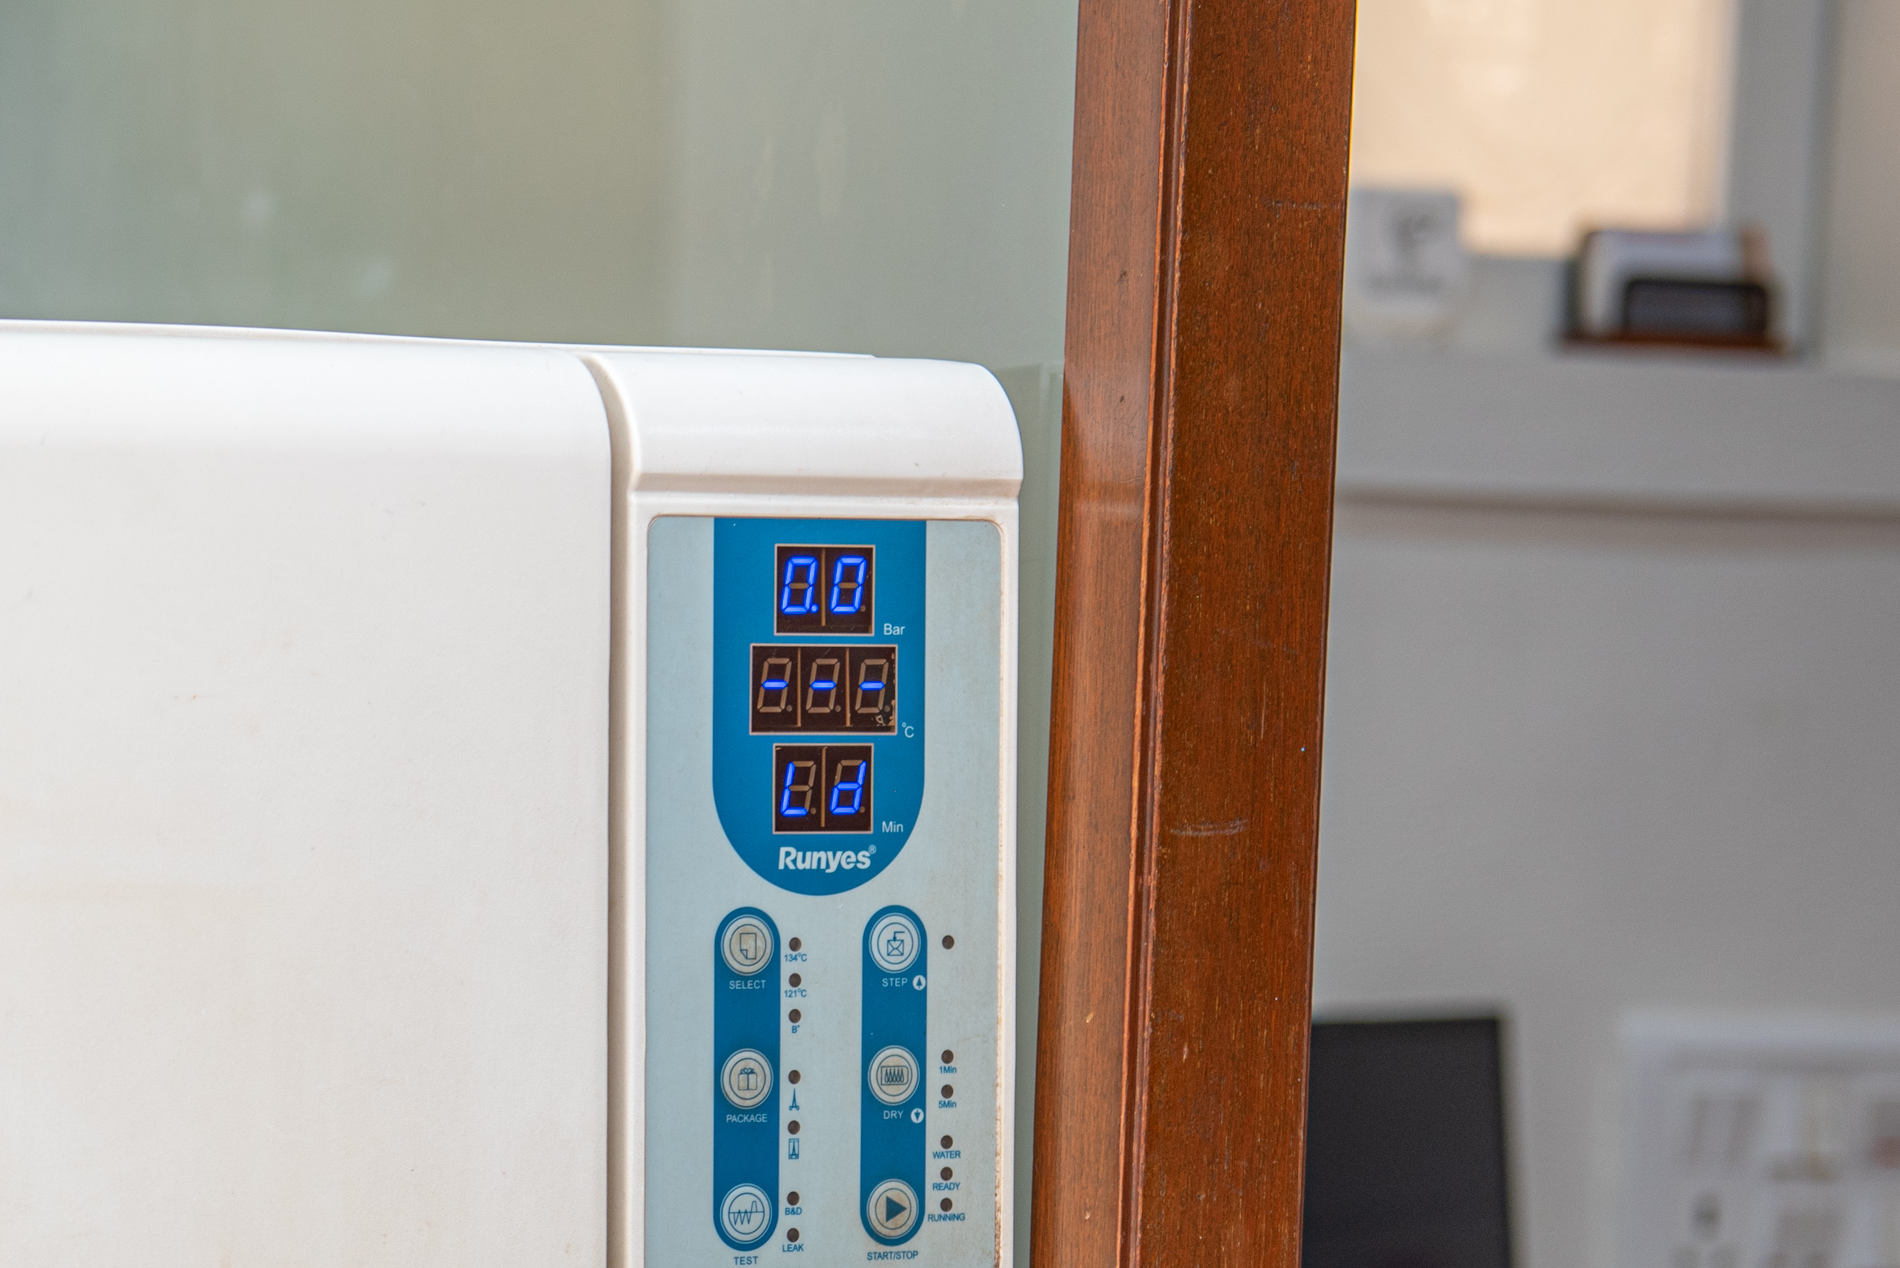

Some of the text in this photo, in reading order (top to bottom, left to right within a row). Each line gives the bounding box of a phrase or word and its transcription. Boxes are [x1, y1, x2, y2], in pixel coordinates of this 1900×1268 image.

[780, 555, 868, 615] 0.0
[883, 623, 906, 636] Bar
[881, 821, 904, 834] Min
[729, 980, 767, 989] SELECT
[882, 978, 908, 987] STEP
[939, 1065, 957, 1074] 1Min
[938, 1100, 957, 1109] 5Min
[726, 1114, 768, 1124] PACKAGE
[883, 1111, 904, 1120] DRY
[932, 1150, 961, 1159] WATER
[932, 1182, 960, 1191] READY
[784, 1207, 802, 1215] B&D
[928, 1213, 966, 1222] RUNNING
[782, 1243, 804, 1253] LEAK
[867, 1250, 919, 1260] START/STOP
[733, 1256, 758, 1265] TEST
